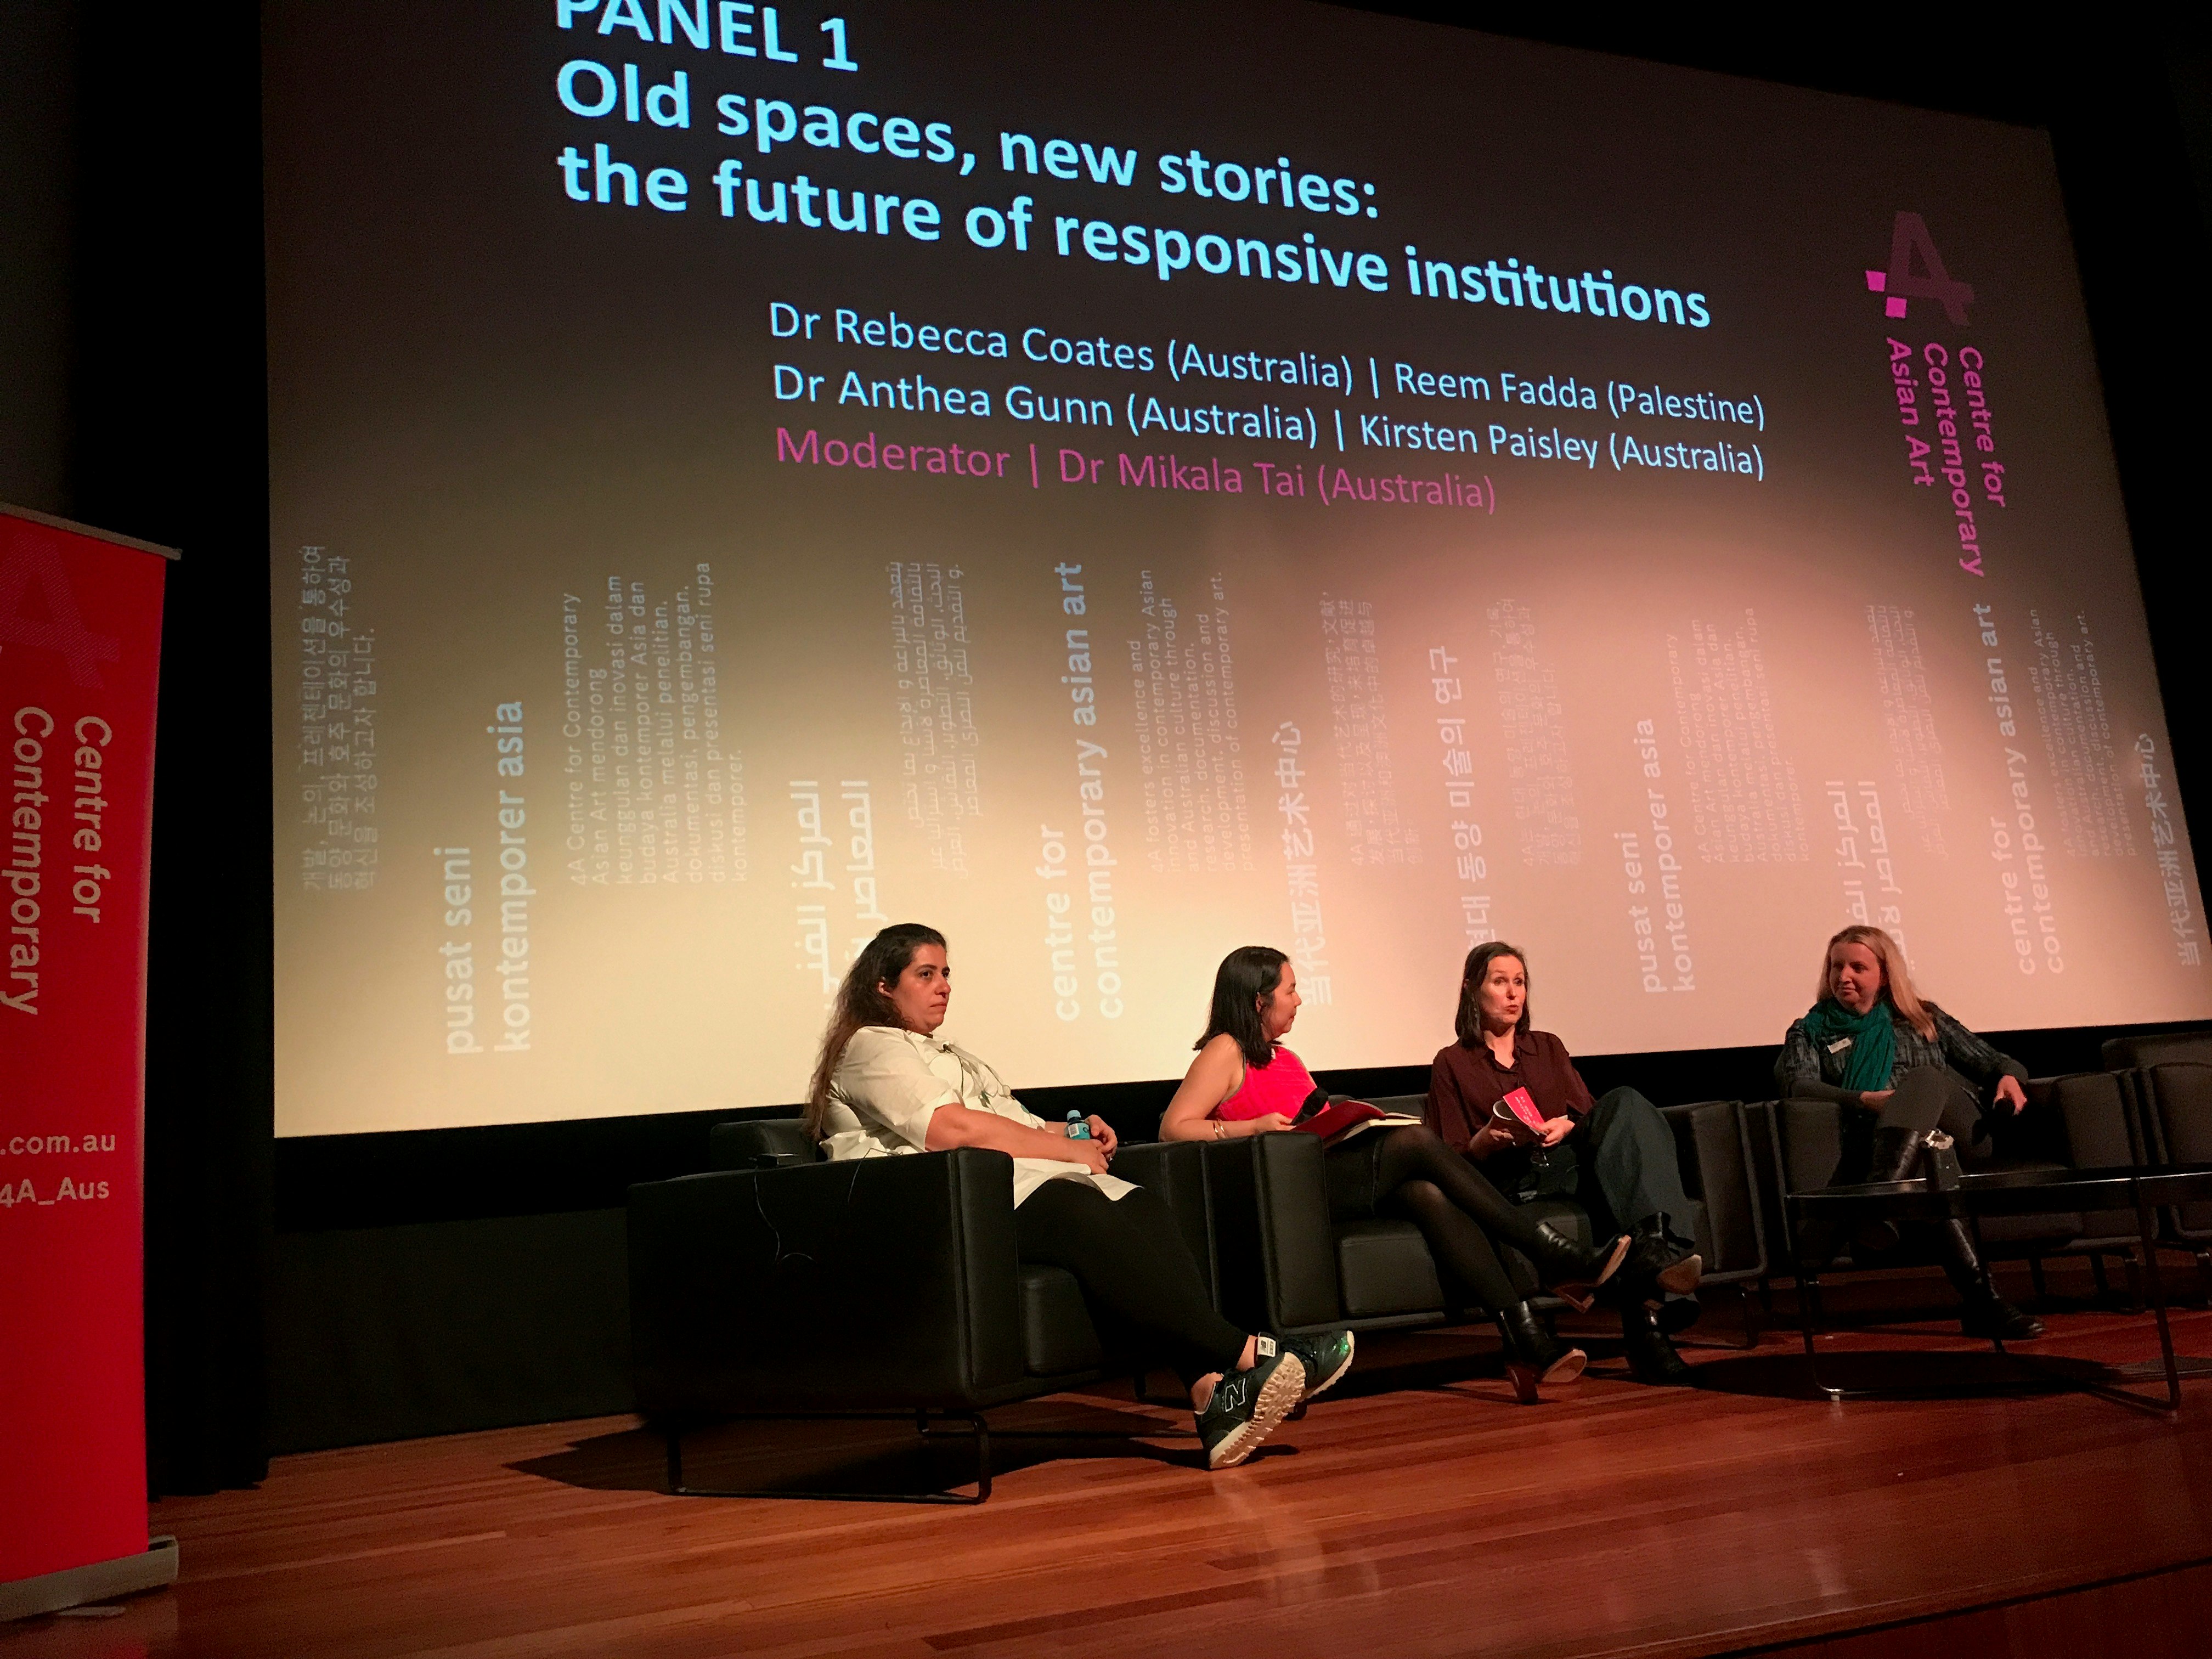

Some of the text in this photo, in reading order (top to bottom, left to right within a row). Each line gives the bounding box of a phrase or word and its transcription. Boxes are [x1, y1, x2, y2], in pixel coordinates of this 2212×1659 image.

[556, 0, 859, 71] PANEL 1
[557, 59, 1378, 219] Old spaces, new stories:
[557, 143, 1711, 328] the future of responsive institutions
[770, 302, 821, 340] Dr
[836, 308, 1008, 358] Rebecca
[1022, 327, 1154, 371] Coates
[1168, 339, 1352, 396] (Australia)
[1395, 363, 1490, 400] Reem
[1500, 373, 1597, 410] Fadda
[1608, 381, 1764, 432] (Palestine)
[774, 364, 825, 402] Dr
[838, 371, 991, 416] Anthea
[1006, 385, 1113, 426] Gunn
[1127, 393, 1317, 449] (Australia)
[1361, 414, 1477, 453] Kirsten
[1488, 425, 1598, 469] Paisley
[1610, 432, 1764, 482] (Australia)
[1886, 337, 1934, 486] Asian Art
[1959, 346, 2005, 507] Centre for
[776, 427, 1011, 477] Moderator
[1059, 449, 1104, 484] Dr
[1118, 453, 1243, 493] Mikala
[1253, 462, 1304, 496] Tai
[1318, 465, 1495, 515] (Australia)
[1923, 342, 1984, 577] Contemporary
[562, 592, 583, 737] Contemporary
[1195, 613, 1212, 645] and
[1201, 651, 1227, 743] discussion
[1429, 645, 1462, 704] 연구
[2027, 667, 2042, 692] and
[2029, 609, 2049, 647] Asian
[2039, 652, 2067, 754] contemporary
[564, 745, 583, 773] for
[586, 668, 610, 885] Asian Art mendorong
[605, 575, 636, 884] keunggulan dan inovasi dalam
[628, 582, 659, 884] budaya kontemporer Asia dan
[654, 712, 675, 785] melalui
[693, 562, 726, 883] diskusi dan presentasi seni rupa
[1054, 561, 1124, 1018] contemporary asian art
[1126, 640, 1165, 873] 4A fosters excellence and
[1139, 569, 1181, 872] innovation in contemporary Asian
[1158, 597, 1200, 872] and Australian culture through
[1209, 571, 1253, 870] presentation of contemporary art.
[1436, 718, 1475, 807] 미술의
[1972, 603, 2063, 973] contemporary asian art
[2036, 698, 2059, 776] excellence
[2061, 759, 2074, 772] in
[0, 705, 54, 1015] Contemporary
[73, 715, 112, 923] Centre for
[486, 701, 537, 1051] kontemporer asia
[566, 781, 585, 850] Centre
[658, 793, 680, 883] Australia
[729, 749, 748, 881] kontemporer.
[789, 780, 836, 890] المركز
[1451, 820, 1487, 882] 동양
[1633, 718, 1695, 990] kontemporer asia
[432, 847, 484, 1054] pusat seni
[1038, 823, 1080, 1020] centre for
[1613, 832, 1668, 992] pusat seni
[1990, 816, 2035, 974] centre for
